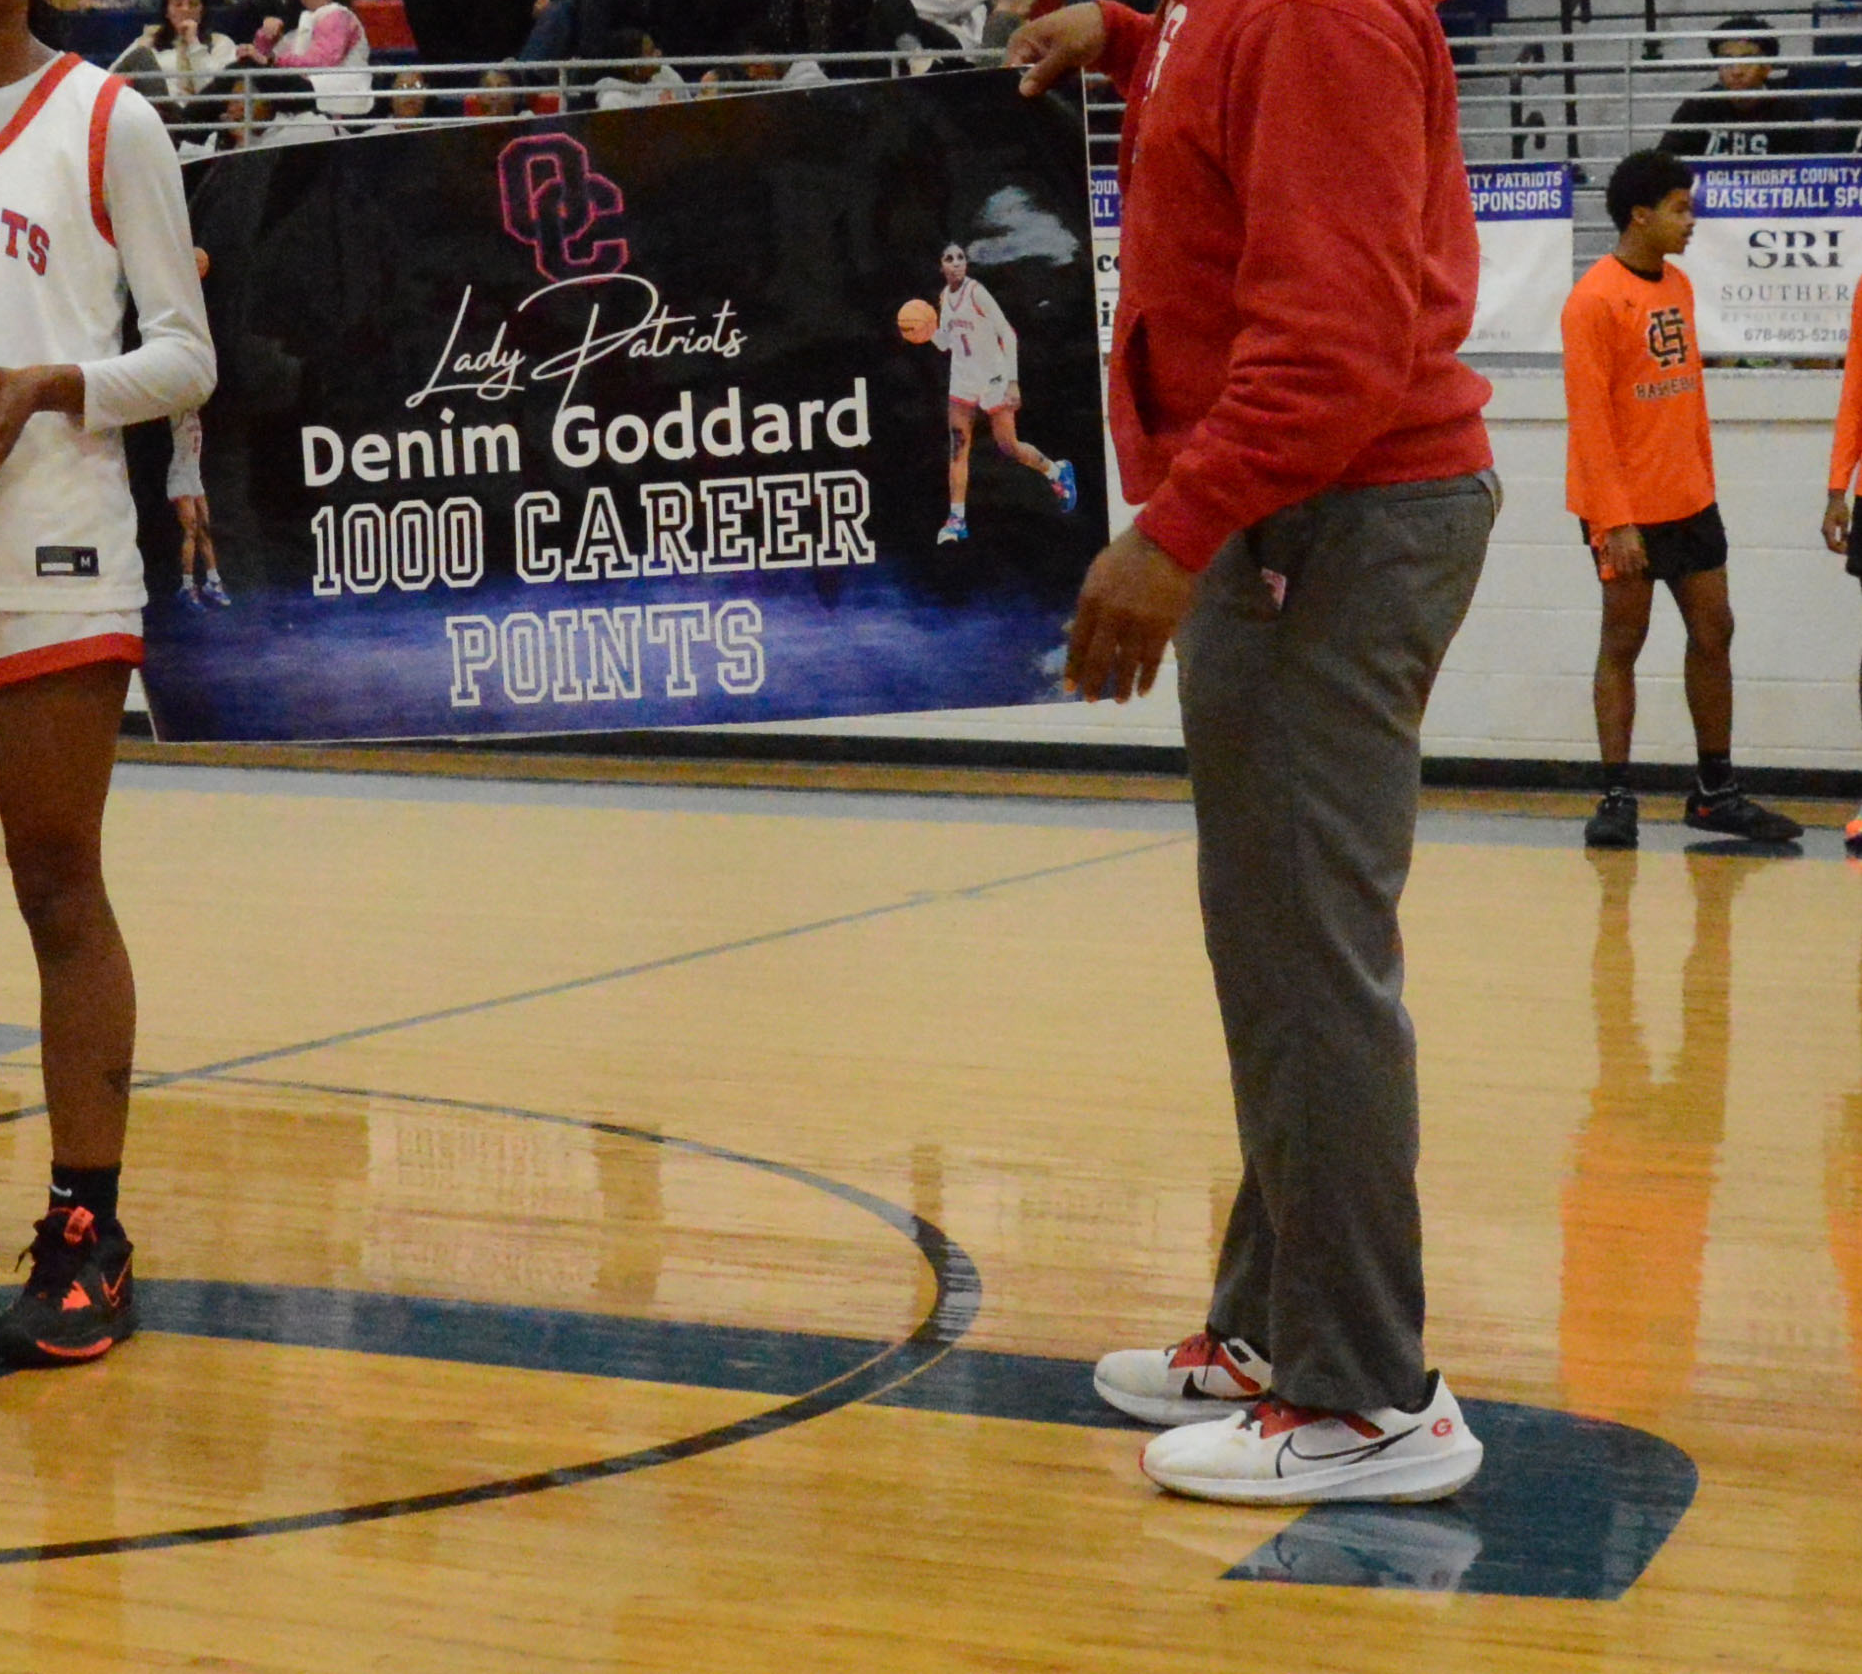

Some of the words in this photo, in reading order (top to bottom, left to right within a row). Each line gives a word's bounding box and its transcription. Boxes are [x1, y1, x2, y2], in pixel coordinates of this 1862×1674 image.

[1496, 171, 1563, 189] PATRIOTS
[1706, 169, 1797, 187] OGLETHORPE
[1800, 167, 1862, 184] COUNTY
[1706, 186, 1830, 208] BASKETBALL
[1747, 229, 1845, 269] SRI
[407, 284, 526, 404] Lady
[518, 273, 747, 420] Patriots
[301, 408, 521, 488] Denim
[552, 376, 872, 468] Goddard
[311, 496, 484, 597] 1000
[514, 469, 876, 583] CAREER
[446, 599, 766, 708] POINTS
